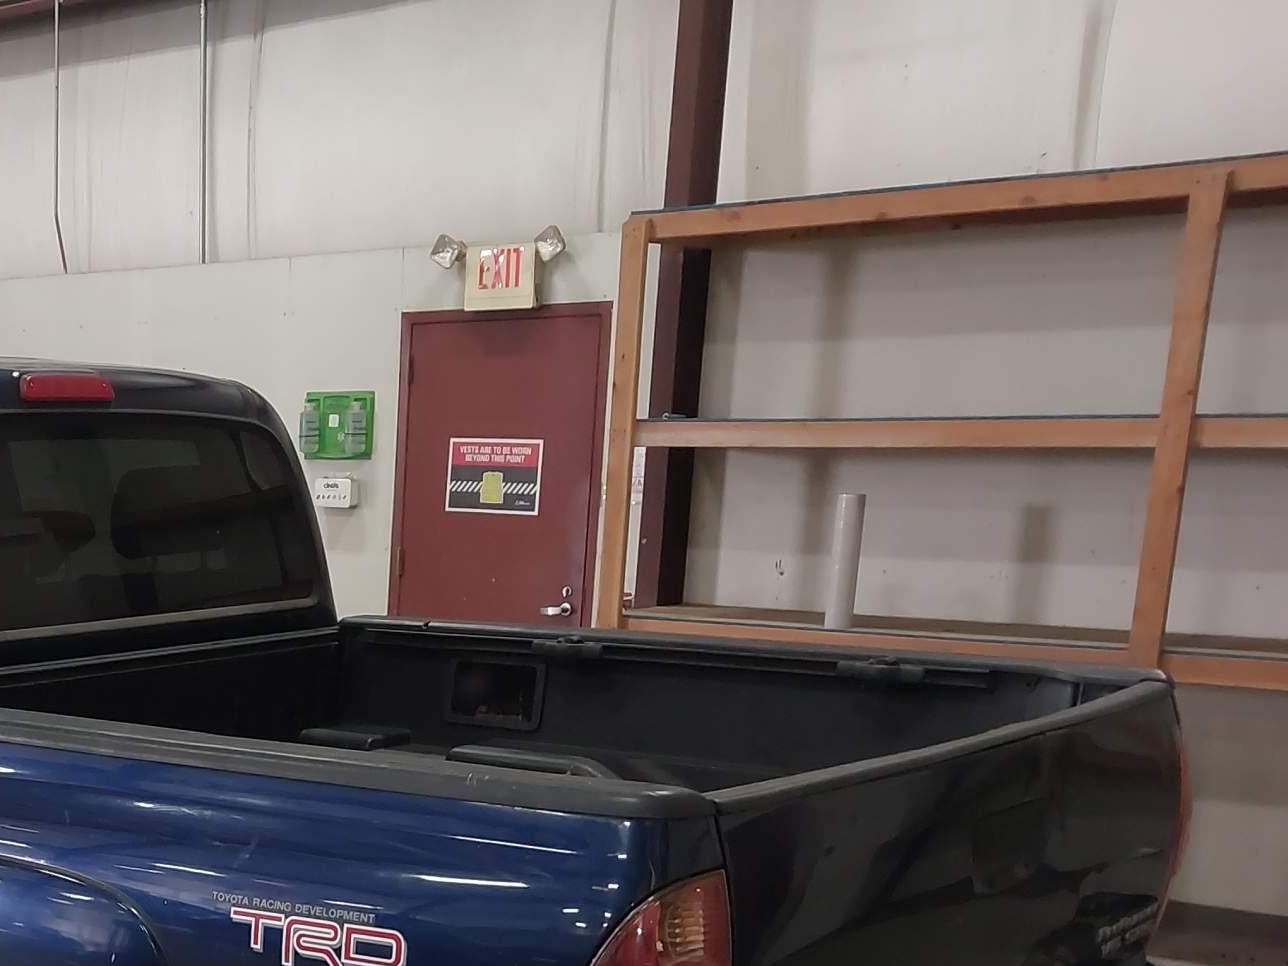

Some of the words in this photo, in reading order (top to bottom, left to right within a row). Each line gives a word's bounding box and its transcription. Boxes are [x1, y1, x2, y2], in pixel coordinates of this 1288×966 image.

[478, 247, 522, 289] EXIT
[480, 446, 492, 454] ARE
[493, 446, 502, 454] TO
[212, 891, 249, 906] TOYOTA
[252, 897, 292, 912] RACING
[295, 903, 376, 924] DEVELOPMENT
